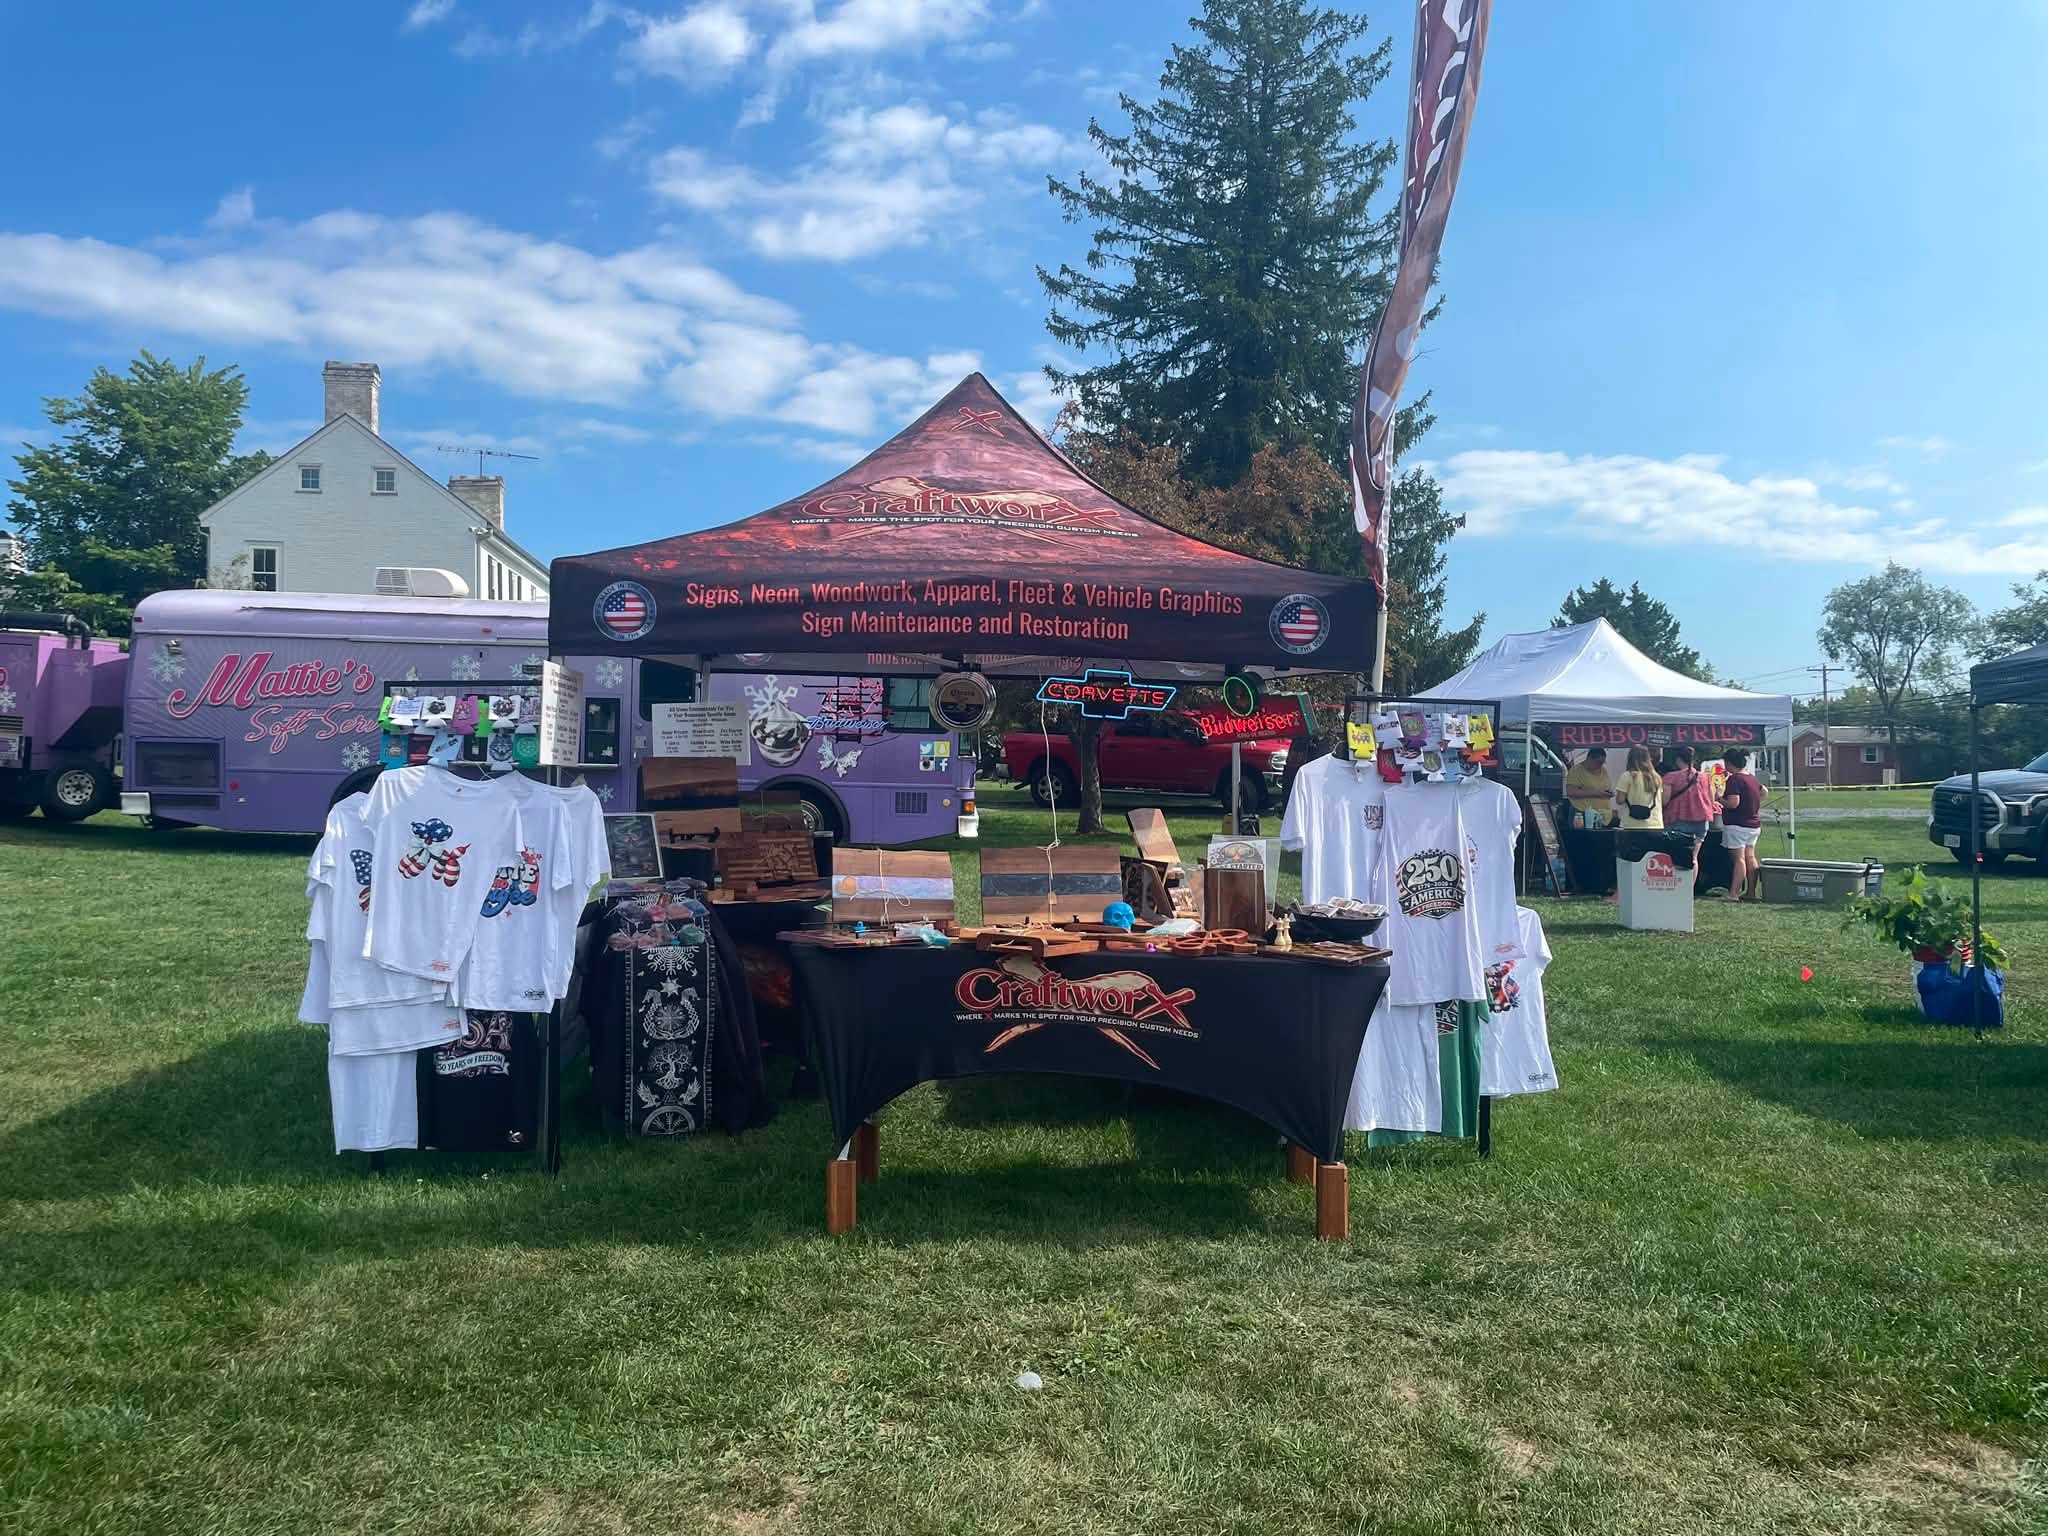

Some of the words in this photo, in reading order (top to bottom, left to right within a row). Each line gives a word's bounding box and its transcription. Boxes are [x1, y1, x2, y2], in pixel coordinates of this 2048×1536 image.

[998, 520, 1054, 529] PRECISION
[1056, 525, 1101, 534] CUSTOM
[1103, 529, 1139, 537] NEEDS
[686, 583, 744, 608] Signs,
[751, 583, 804, 605] Neon,
[811, 579, 917, 605] Woodwork,
[924, 579, 1001, 606] Apparel,
[1008, 580, 1055, 605] Fleet
[1062, 582, 1077, 606] &
[1083, 583, 1152, 609] Vehicle
[1159, 587, 1242, 616] Graphics
[802, 611, 844, 637] Sign
[851, 610, 973, 633] Maintenance
[979, 612, 1013, 634] and
[1020, 612, 1129, 640] Restoration
[168, 651, 375, 718] Mattie's
[1047, 683, 1166, 705] CORVETTE
[245, 704, 320, 753] Soft
[315, 703, 379, 739] Serv
[1200, 711, 1294, 737] Budweiser
[1561, 725, 1664, 744] RIBBO
[1677, 724, 1754, 743] FRIES
[1405, 854, 1459, 888] 250
[1410, 888, 1460, 907] AMERICA
[956, 1013, 983, 1022] WHERE
[1075, 1015, 1097, 1023] YOUR
[1097, 1017, 1138, 1028] PRECISION
[1139, 1023, 1172, 1034] CUSTOM
[1173, 1027, 1199, 1039] NEEDS
[447, 1060, 466, 1071] YEARS
